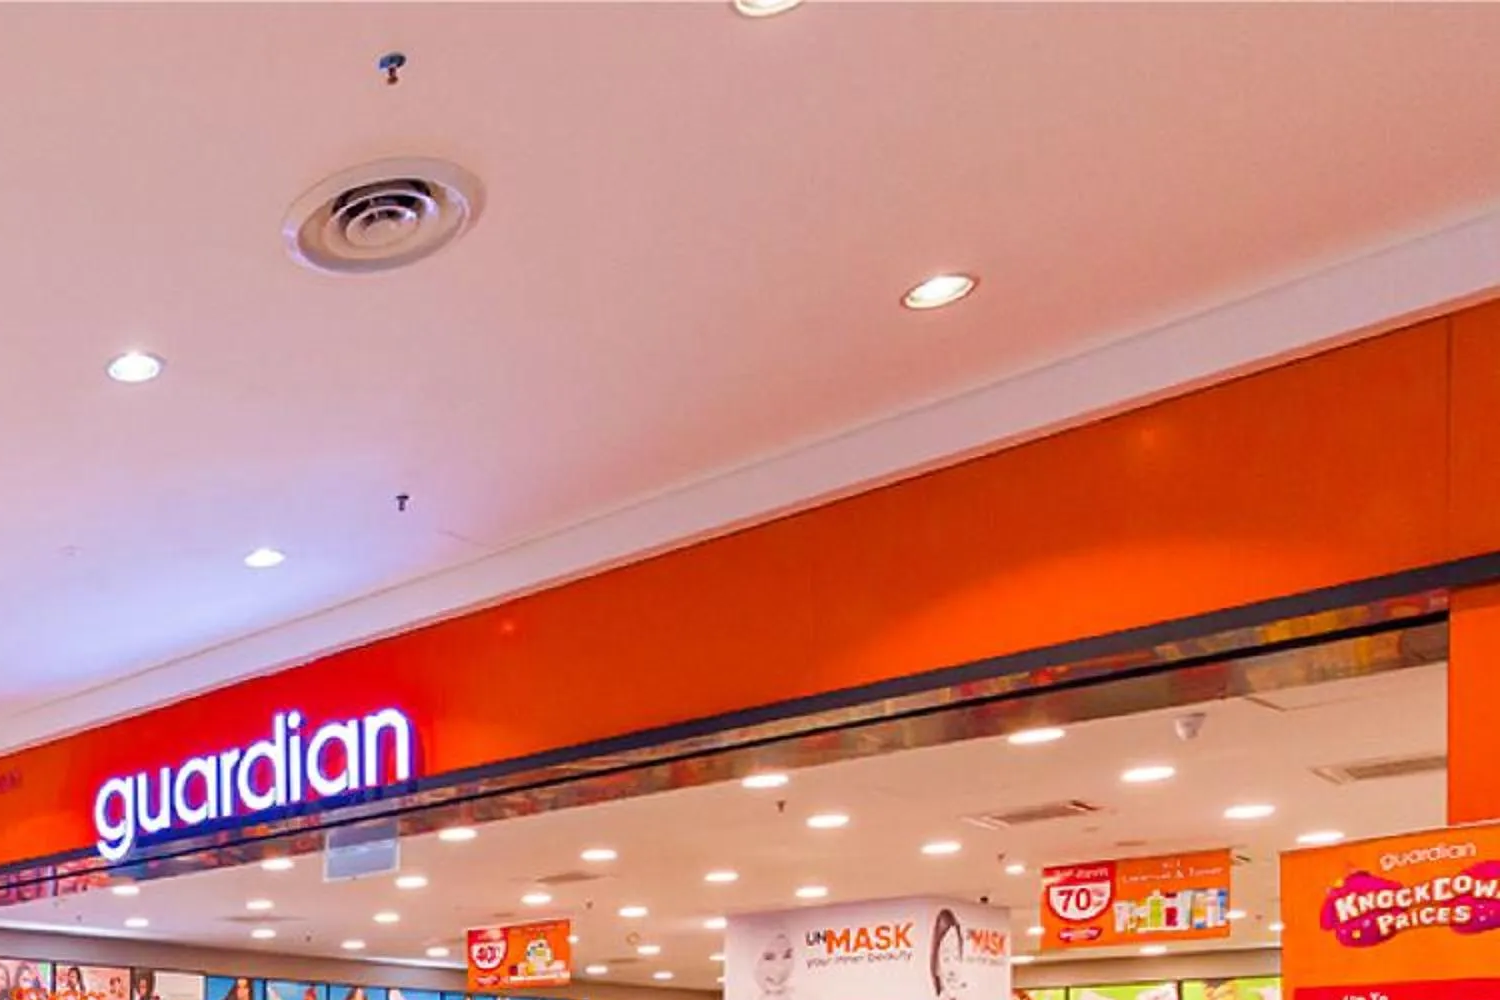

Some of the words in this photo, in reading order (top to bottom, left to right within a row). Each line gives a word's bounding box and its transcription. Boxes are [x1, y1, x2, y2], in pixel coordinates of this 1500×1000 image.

[94, 708, 412, 862] guardian
[1379, 842, 1477, 871] guardian
[1334, 874, 1500, 923] KNOCKDOW
